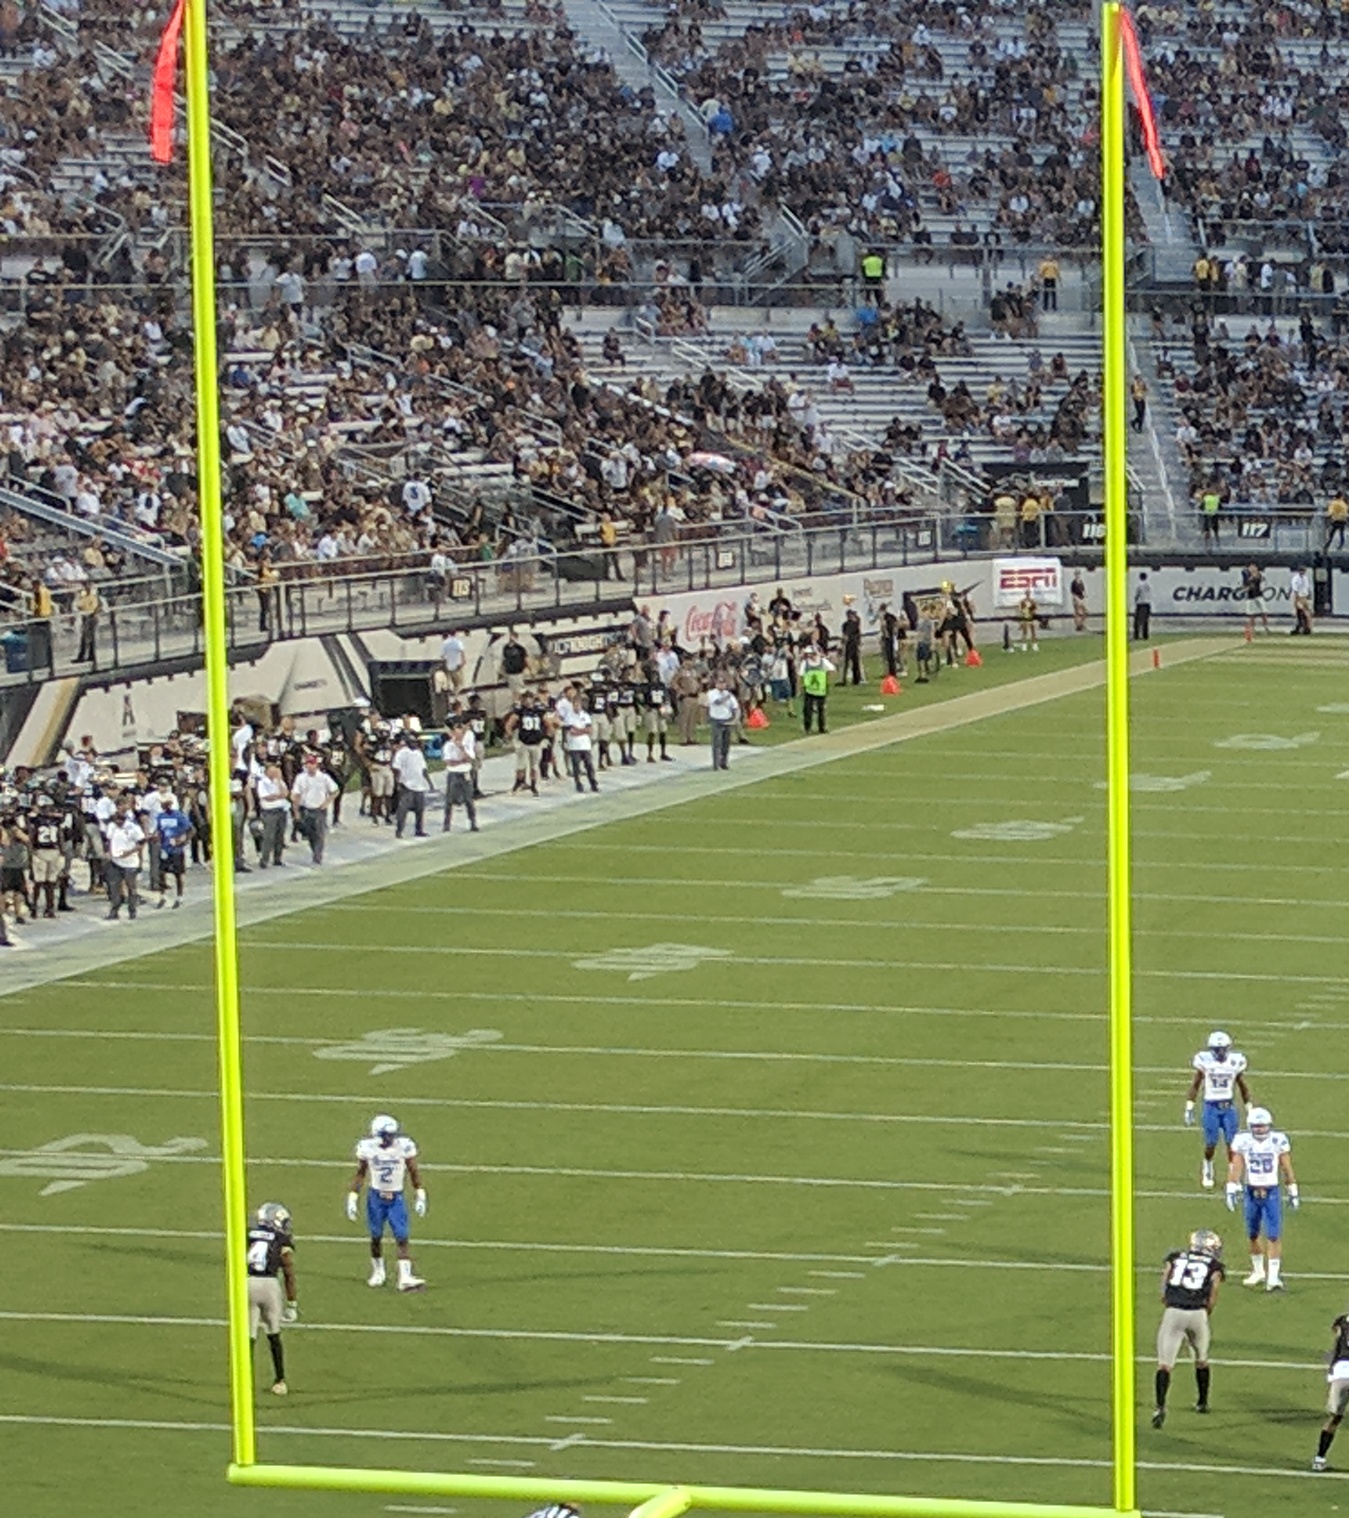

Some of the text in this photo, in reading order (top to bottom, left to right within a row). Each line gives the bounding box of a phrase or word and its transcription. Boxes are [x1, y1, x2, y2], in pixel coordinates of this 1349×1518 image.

[1241, 523, 1268, 538] 117
[1000, 567, 1058, 588] ESPN
[1172, 586, 1247, 602] CHARG
[380, 1167, 393, 1184] 2
[1169, 1258, 1209, 1290] 13
